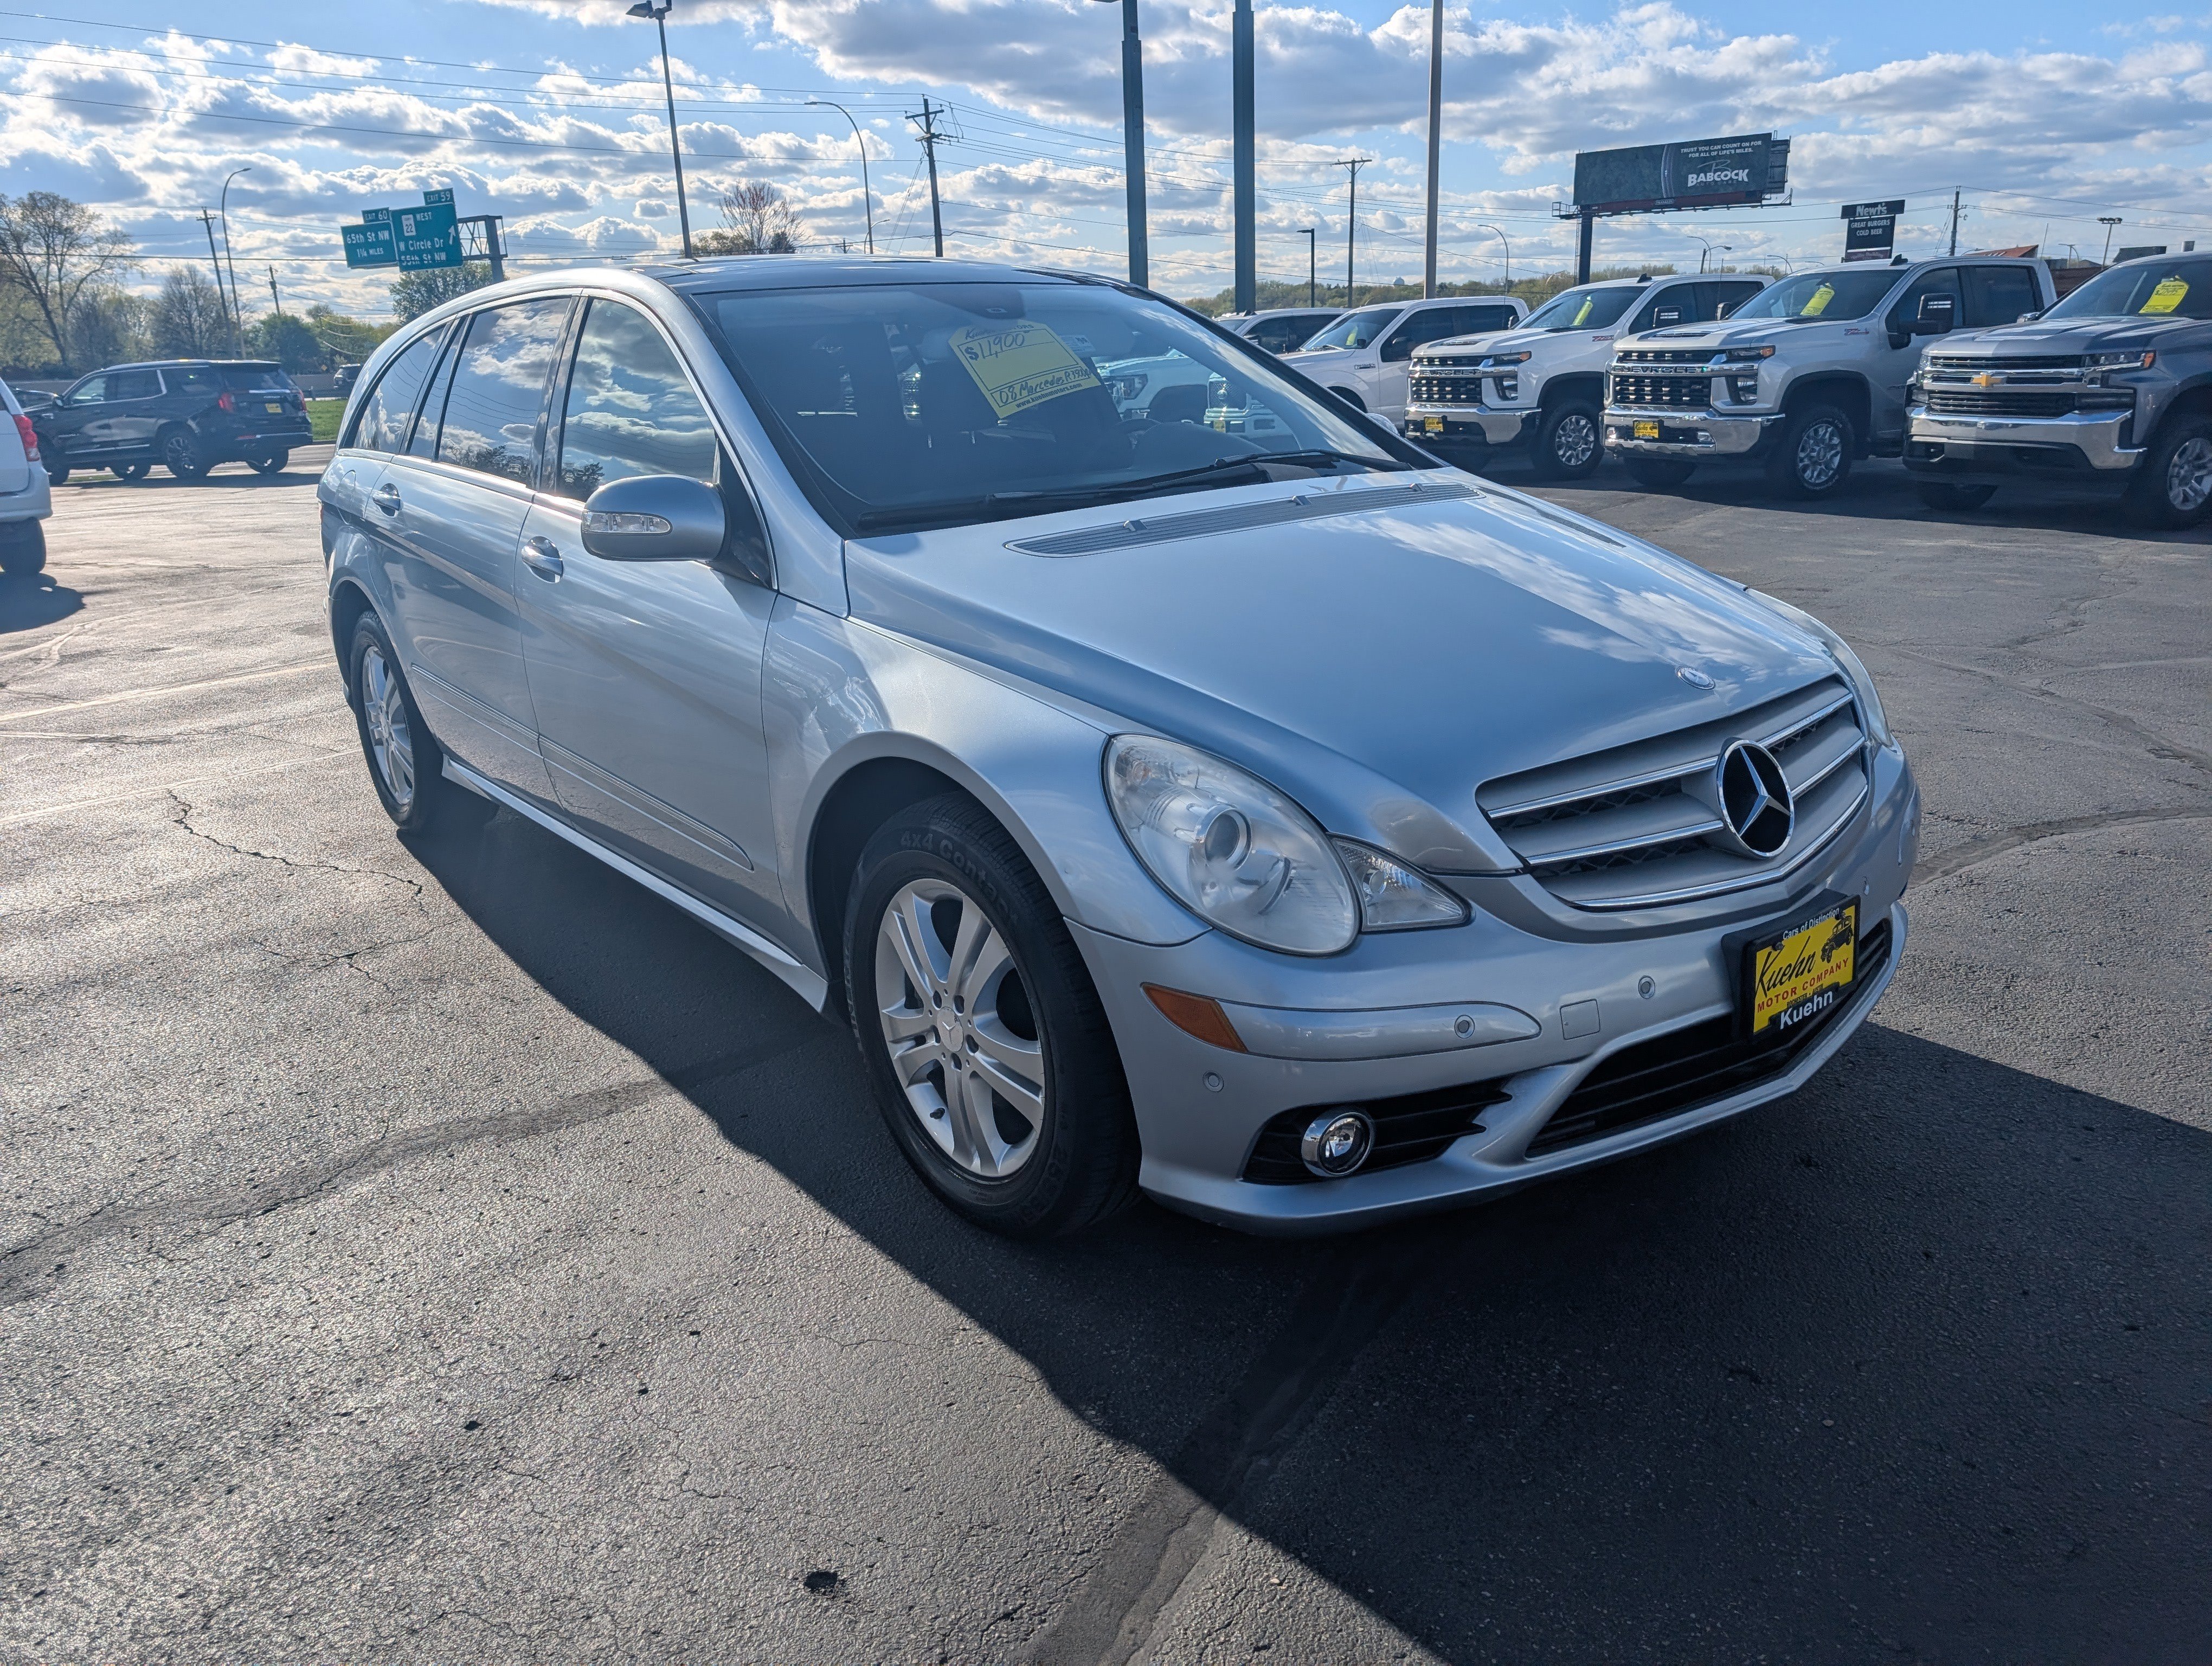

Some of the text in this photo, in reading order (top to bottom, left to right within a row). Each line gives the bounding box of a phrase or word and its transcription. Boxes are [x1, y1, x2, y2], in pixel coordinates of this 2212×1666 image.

[1687, 169, 1749, 187] BABCOCK
[427, 191, 451, 202] EXIT 59
[378, 210, 388, 220] 60
[415, 212, 432, 221] WEST
[1856, 203, 1887, 216] Newt's
[405, 223, 414, 233] 22
[346, 230, 389, 244] 65th St NW
[398, 237, 443, 252] W Circle Dr
[401, 252, 446, 266] 55th St NW
[999, 386, 1018, 404] 08
[1783, 907, 1840, 940] Cars of Distinction
[1756, 935, 1816, 998] Kuehn
[1757, 958, 1849, 1013] MOTOR COMPANY
[1780, 990, 1833, 1030] Kuehn
